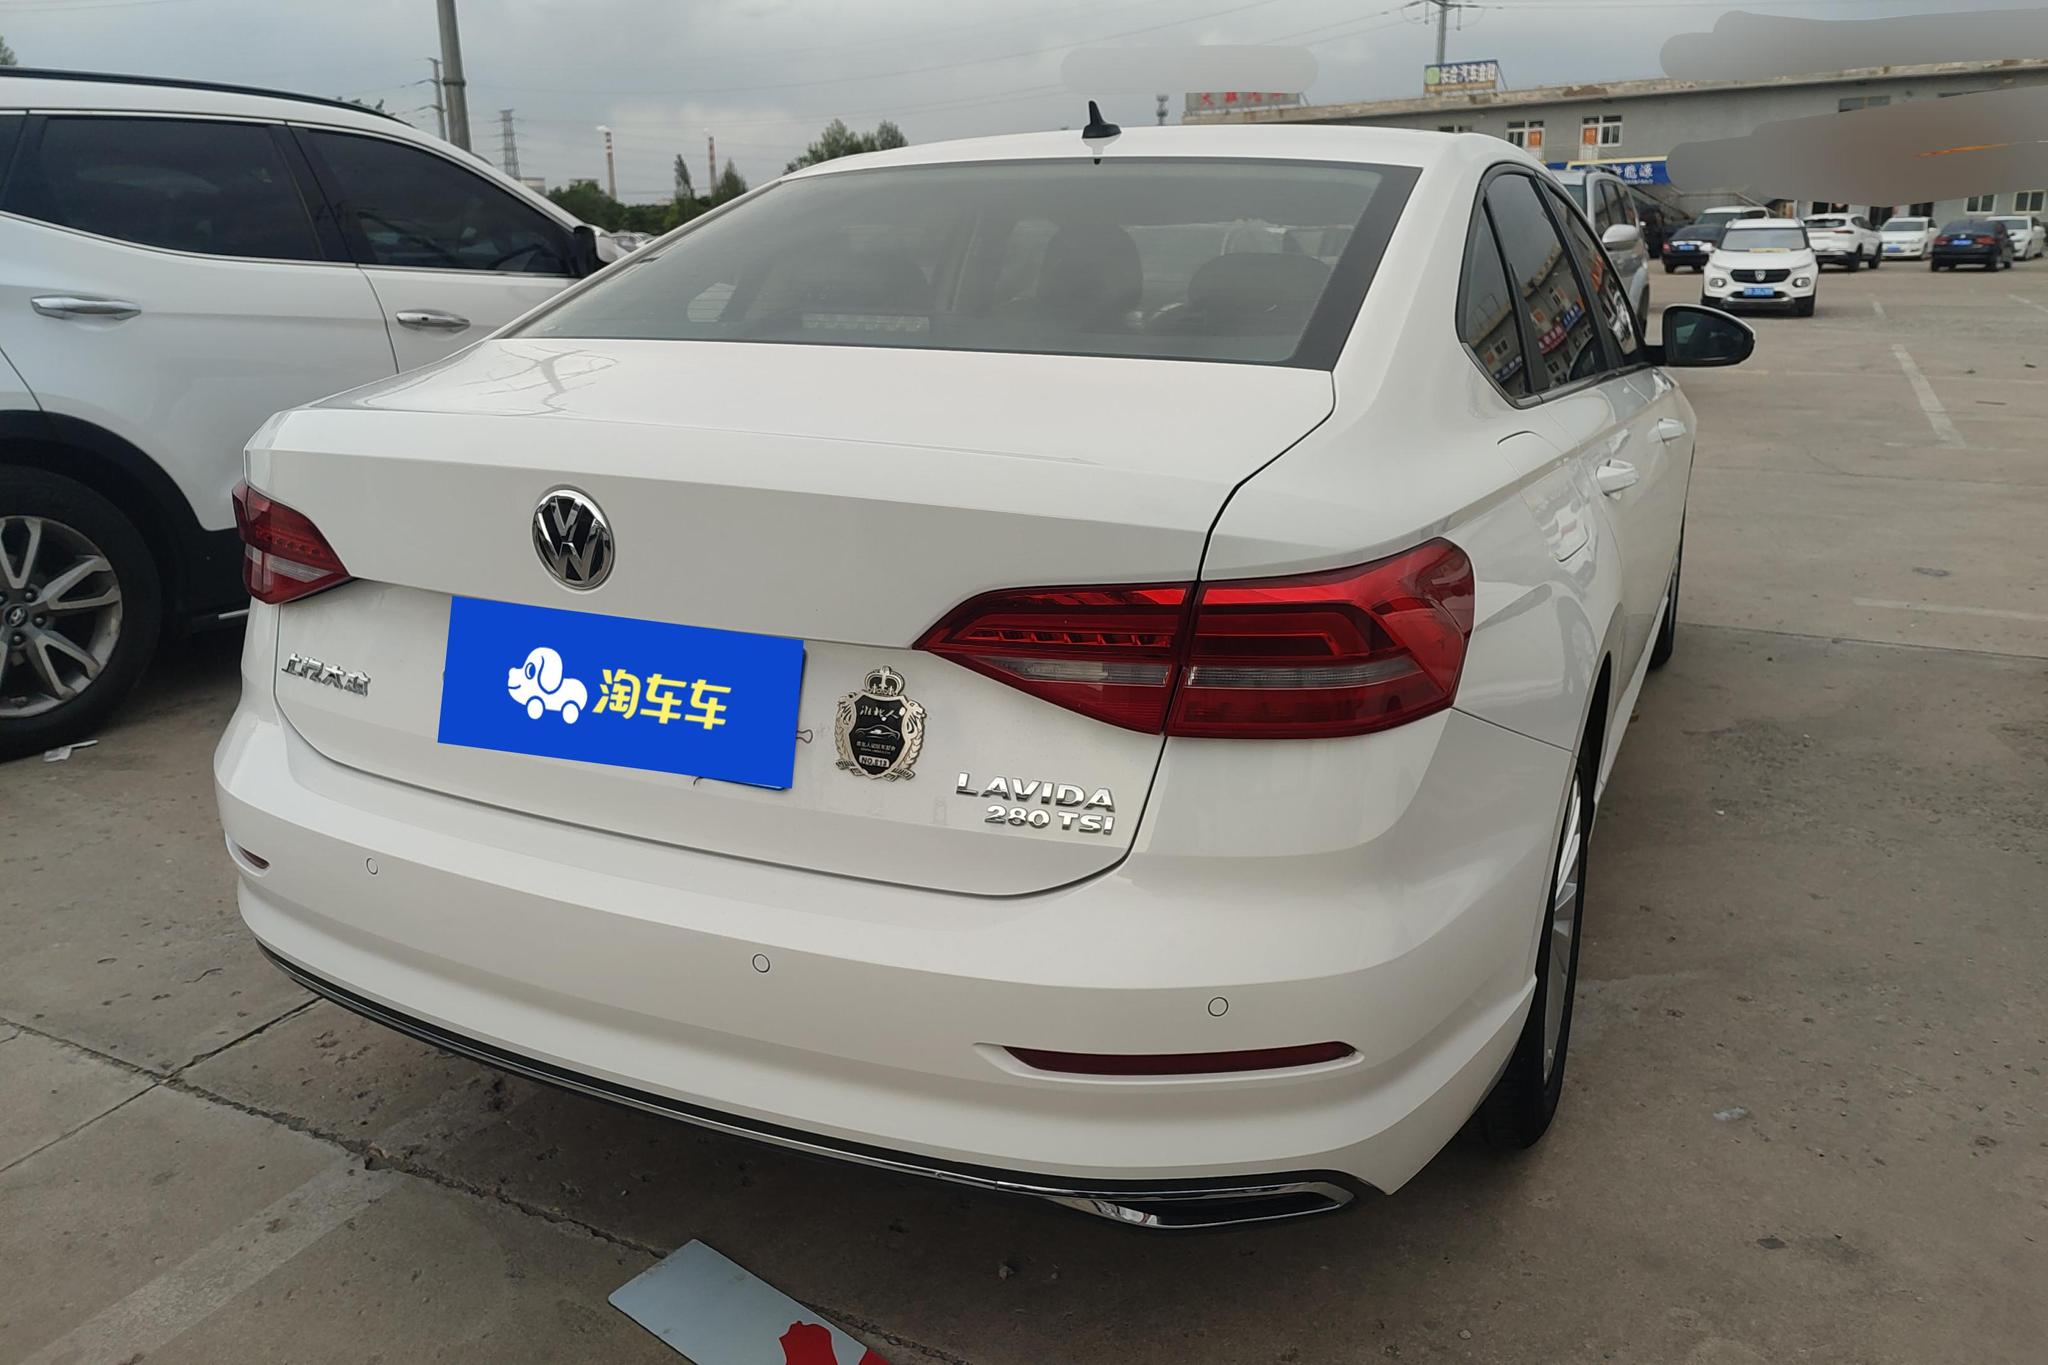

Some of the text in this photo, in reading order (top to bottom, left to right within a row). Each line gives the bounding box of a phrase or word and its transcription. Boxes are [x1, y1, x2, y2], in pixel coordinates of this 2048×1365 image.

[280, 653, 371, 697] 上汽大众
[955, 772, 1116, 813] LAVIDA
[984, 804, 1115, 835] 280 TSI
